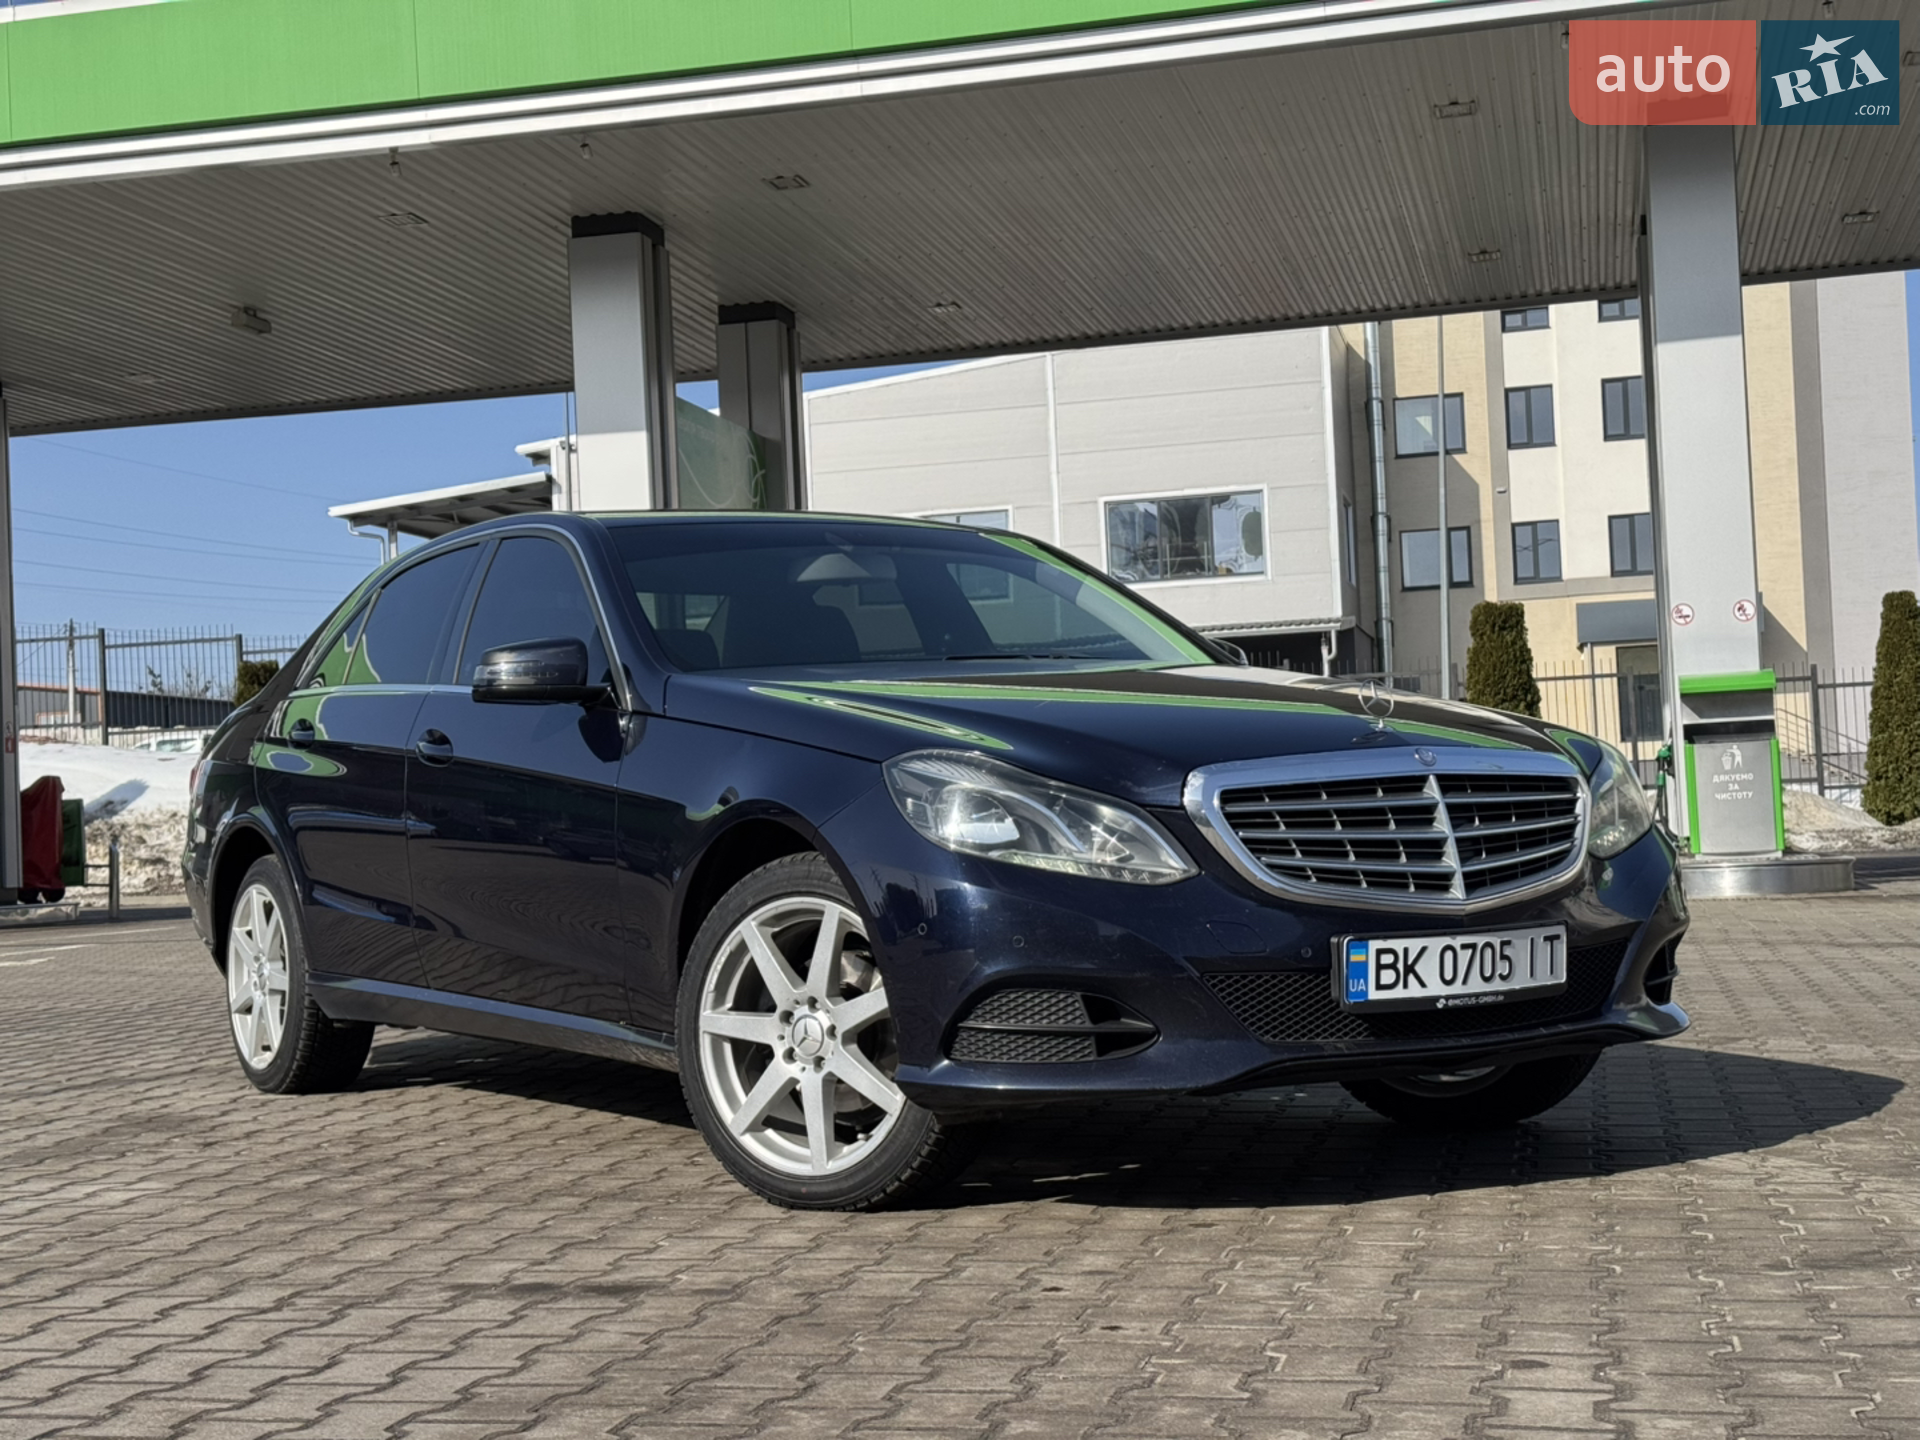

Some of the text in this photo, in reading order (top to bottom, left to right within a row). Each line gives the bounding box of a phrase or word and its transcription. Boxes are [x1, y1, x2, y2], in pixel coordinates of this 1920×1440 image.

[1728, 783, 1740, 791] ЗА
[1714, 791, 1753, 800] ЧИСТОТУ
[1375, 934, 1561, 991] BK 0705 IT
[1349, 979, 1367, 992] UA
